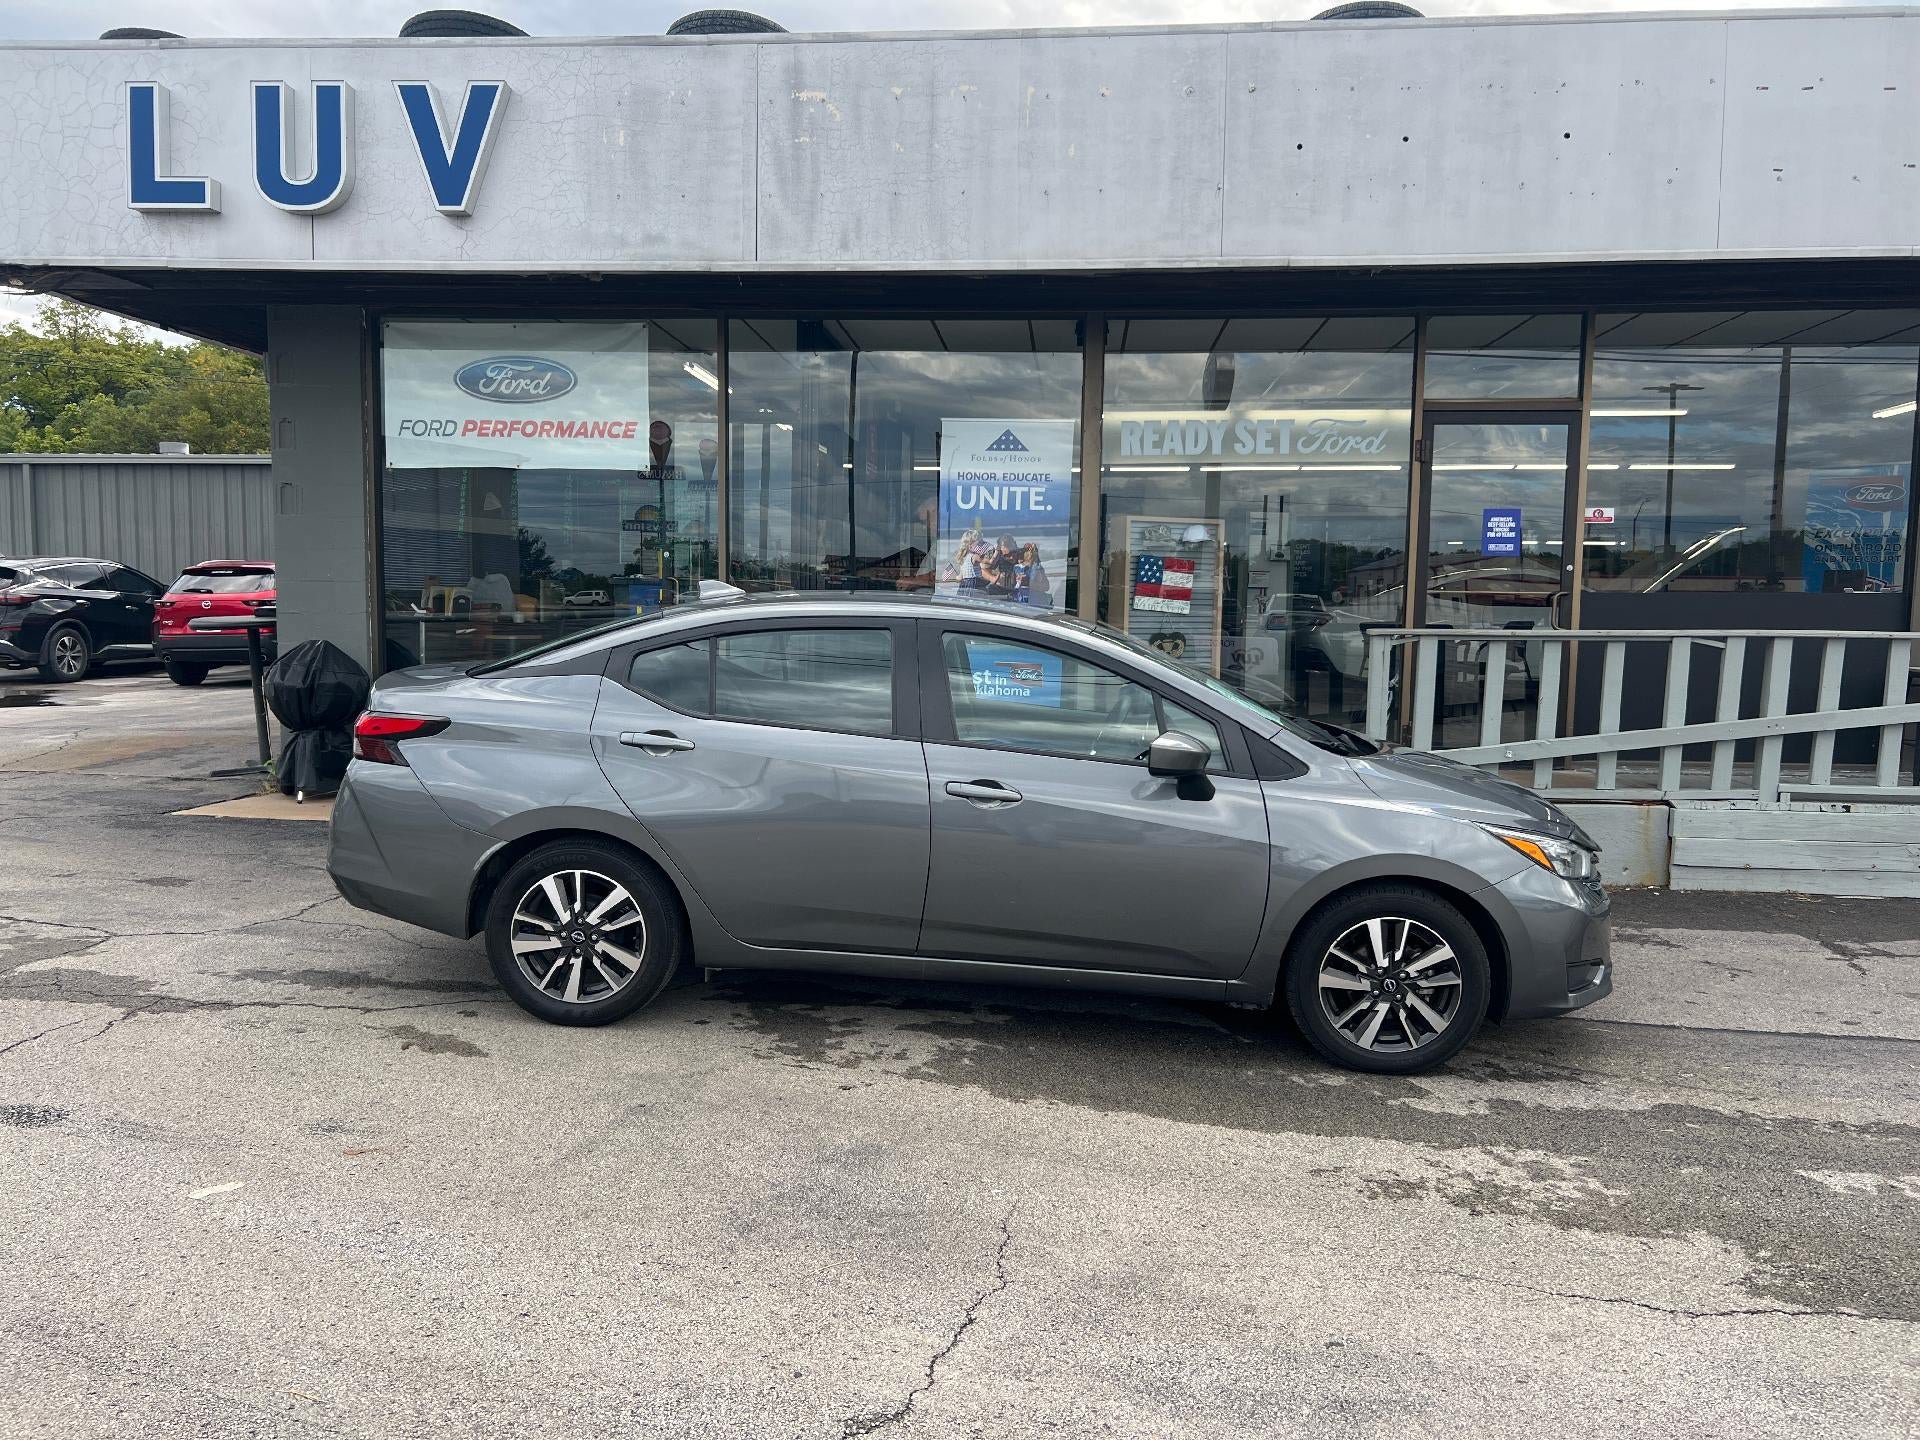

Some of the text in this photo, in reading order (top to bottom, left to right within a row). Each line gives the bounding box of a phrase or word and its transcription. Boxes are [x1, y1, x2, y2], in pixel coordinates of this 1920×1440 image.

[125, 80, 512, 217] LUV
[479, 363, 552, 396] Ford
[398, 419, 638, 439] FORD PERFORMANCE
[1120, 418, 1386, 456] READY SET Ford
[957, 471, 1053, 482] HONOR. EDUCATE.
[956, 485, 1053, 511] UNITE.
[1856, 486, 1893, 500] Ford
[1815, 544, 1832, 552] ON
[1865, 543, 1902, 552] ROAD
[1840, 555, 1862, 563] THE
[1864, 555, 1901, 563] COURT
[995, 674, 1007, 686] in
[974, 684, 1031, 697] klahoma
